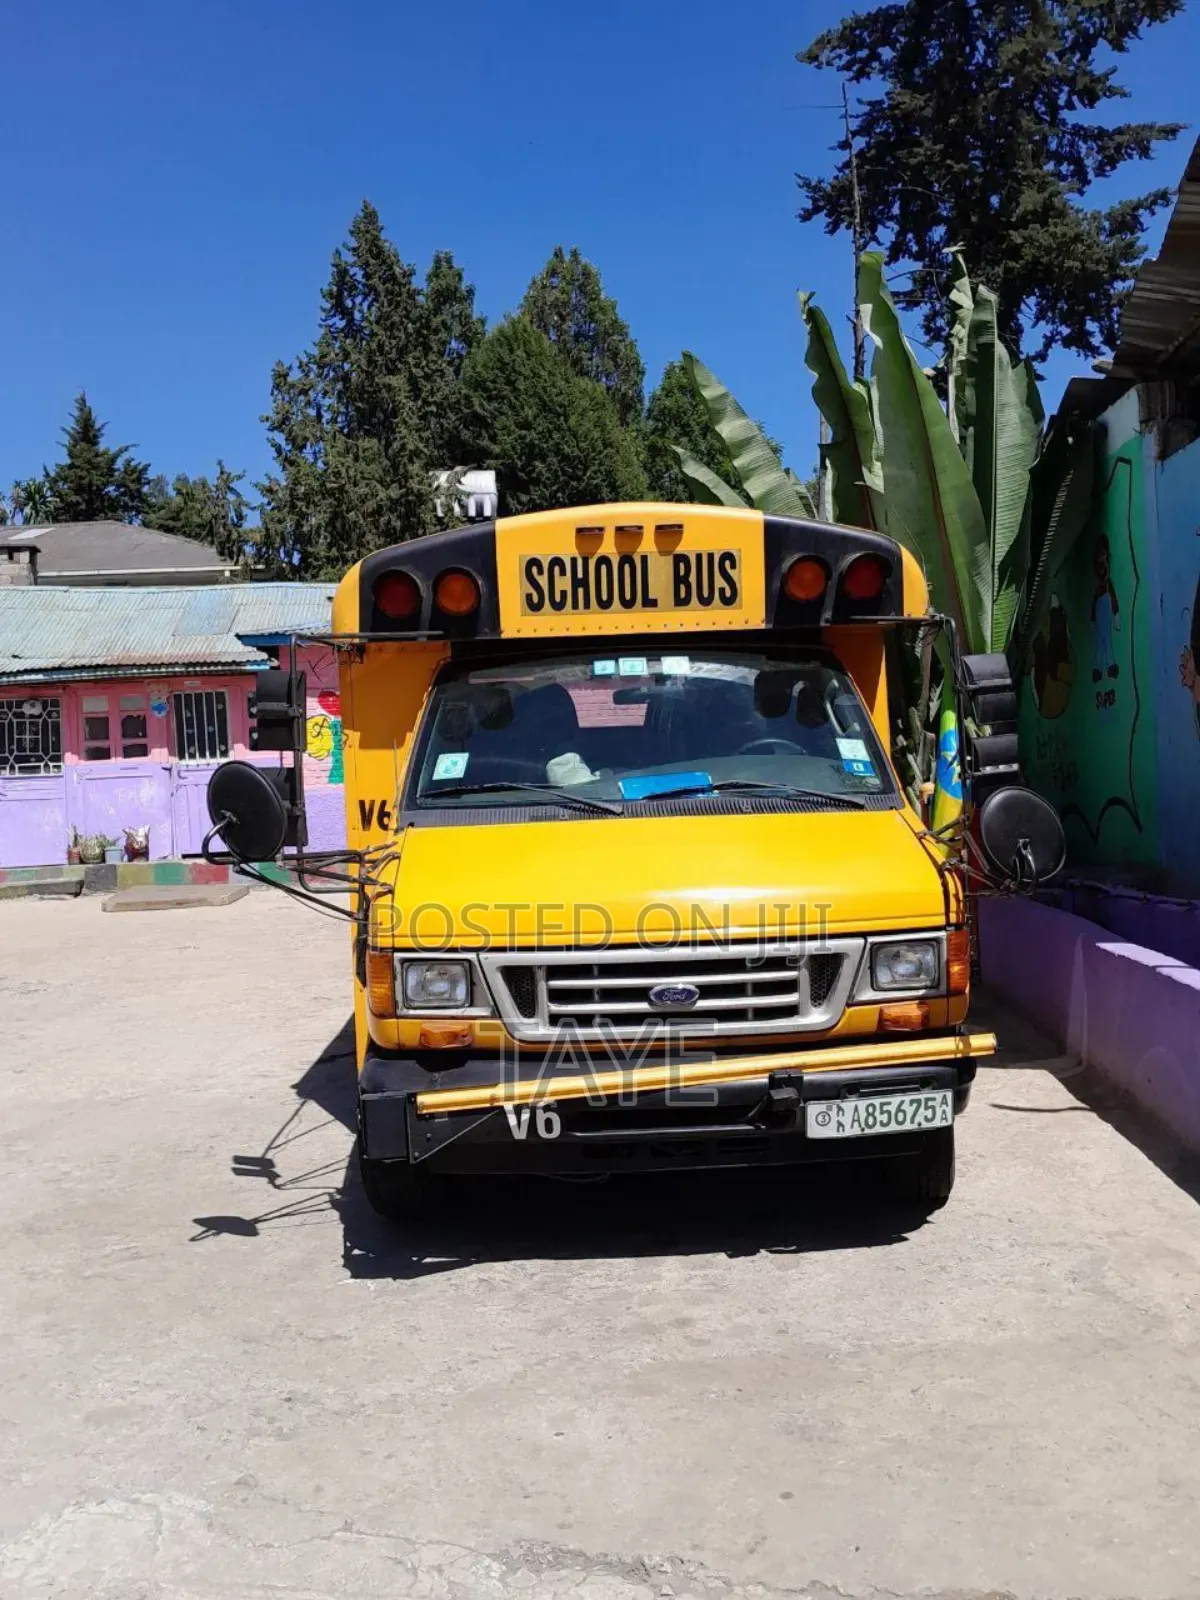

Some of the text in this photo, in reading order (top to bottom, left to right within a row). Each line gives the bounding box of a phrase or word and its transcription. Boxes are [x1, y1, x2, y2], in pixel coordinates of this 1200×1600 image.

[524, 551, 738, 613] SCHOOL BUS
[358, 799, 392, 832] V6
[662, 988, 688, 1002] Ford
[503, 1101, 561, 1140] V6
